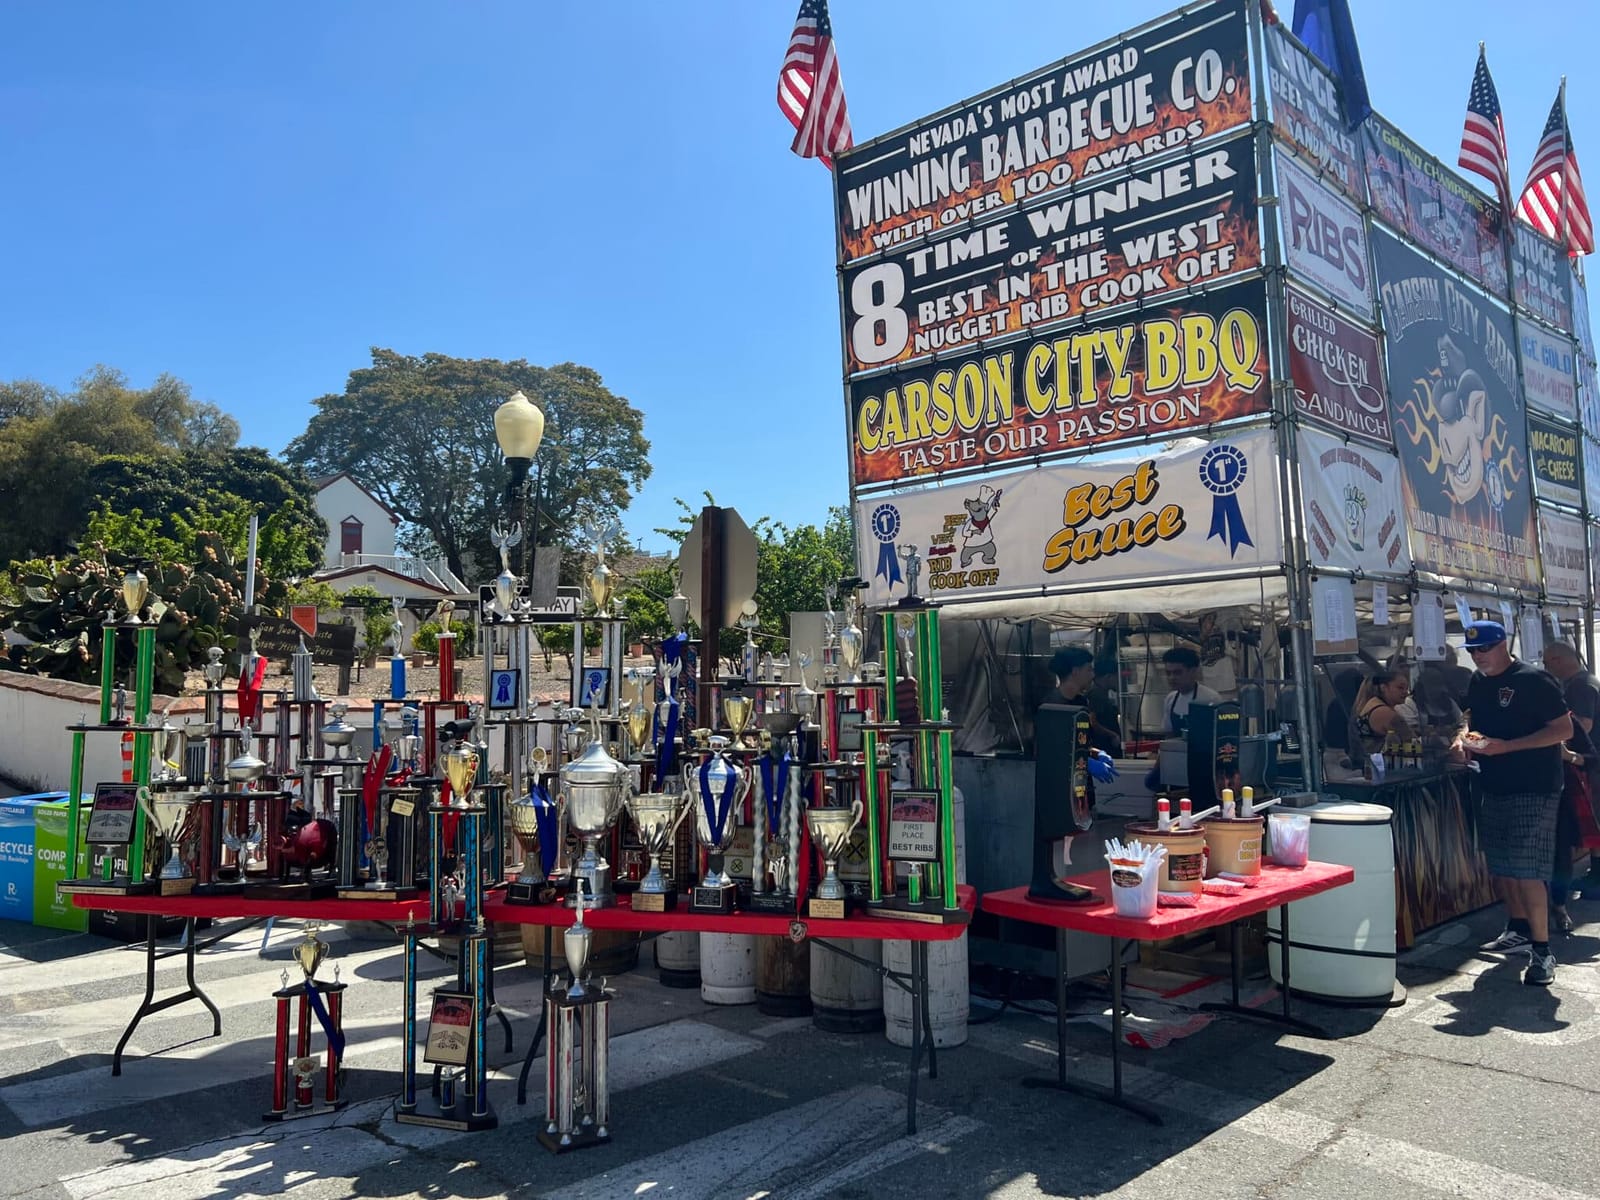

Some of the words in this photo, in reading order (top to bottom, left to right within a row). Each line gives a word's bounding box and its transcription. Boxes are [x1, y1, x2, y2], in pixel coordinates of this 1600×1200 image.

[908, 105, 994, 159] NEVADA'S
[1000, 79, 1056, 124] MOST
[1062, 46, 1140, 99] AWARD
[1275, 29, 1340, 121] HUGE
[847, 149, 971, 232] WINNING
[982, 73, 1155, 184] BARBECUE
[1170, 48, 1237, 112] CO.
[1382, 129, 1423, 170] GRAND
[1423, 161, 1484, 212] CHAMPIONS
[872, 218, 933, 250] WITH
[940, 192, 1004, 224] OVER
[1010, 162, 1072, 200] 100
[1082, 120, 1205, 177] AWARDS
[905, 221, 1010, 278] TIME
[1026, 149, 1238, 240] WINNER
[1010, 244, 1042, 268] OF
[1051, 227, 1106, 255] THE
[1285, 173, 1366, 292] RIBS
[1517, 227, 1557, 277] HUGE
[914, 307, 1011, 353] NUGGET
[1021, 294, 1070, 324] RIB
[1081, 269, 1163, 306] COOK
[1176, 244, 1237, 283] OFF
[917, 284, 989, 328] BEST
[999, 271, 1032, 303] IN
[1041, 249, 1109, 292] THE
[1120, 212, 1226, 267] WEST
[1512, 260, 1566, 304] PORK
[851, 261, 910, 365] 8
[1290, 296, 1337, 337] GRILLED
[1381, 277, 1444, 343] CARSON
[1444, 278, 1480, 345] CITY
[858, 350, 1015, 454] CARSON
[1023, 324, 1137, 415] CITY
[1144, 306, 1263, 394] BBQ
[1292, 324, 1369, 386] CHICKEN
[899, 437, 978, 472] TASTE
[984, 422, 1049, 456] OUR
[1057, 392, 1204, 444] PASSION
[1293, 387, 1389, 437] SANDWICH
[1531, 431, 1576, 458] MACARONI
[1547, 459, 1576, 481] CHEESE
[1062, 459, 1161, 530] Best
[927, 557, 952, 574] RIB
[1041, 503, 1187, 575] Sauce
[929, 568, 999, 591] COOK-OFF
[260, 621, 275, 633] San
[0, 841, 33, 856] ECYCLE
[37, 848, 85, 865] COMPT
[892, 842, 913, 851] BEST
[914, 843, 934, 852] RIBS
[901, 831, 925, 839] PLACE
[903, 823, 923, 831] FIRST
